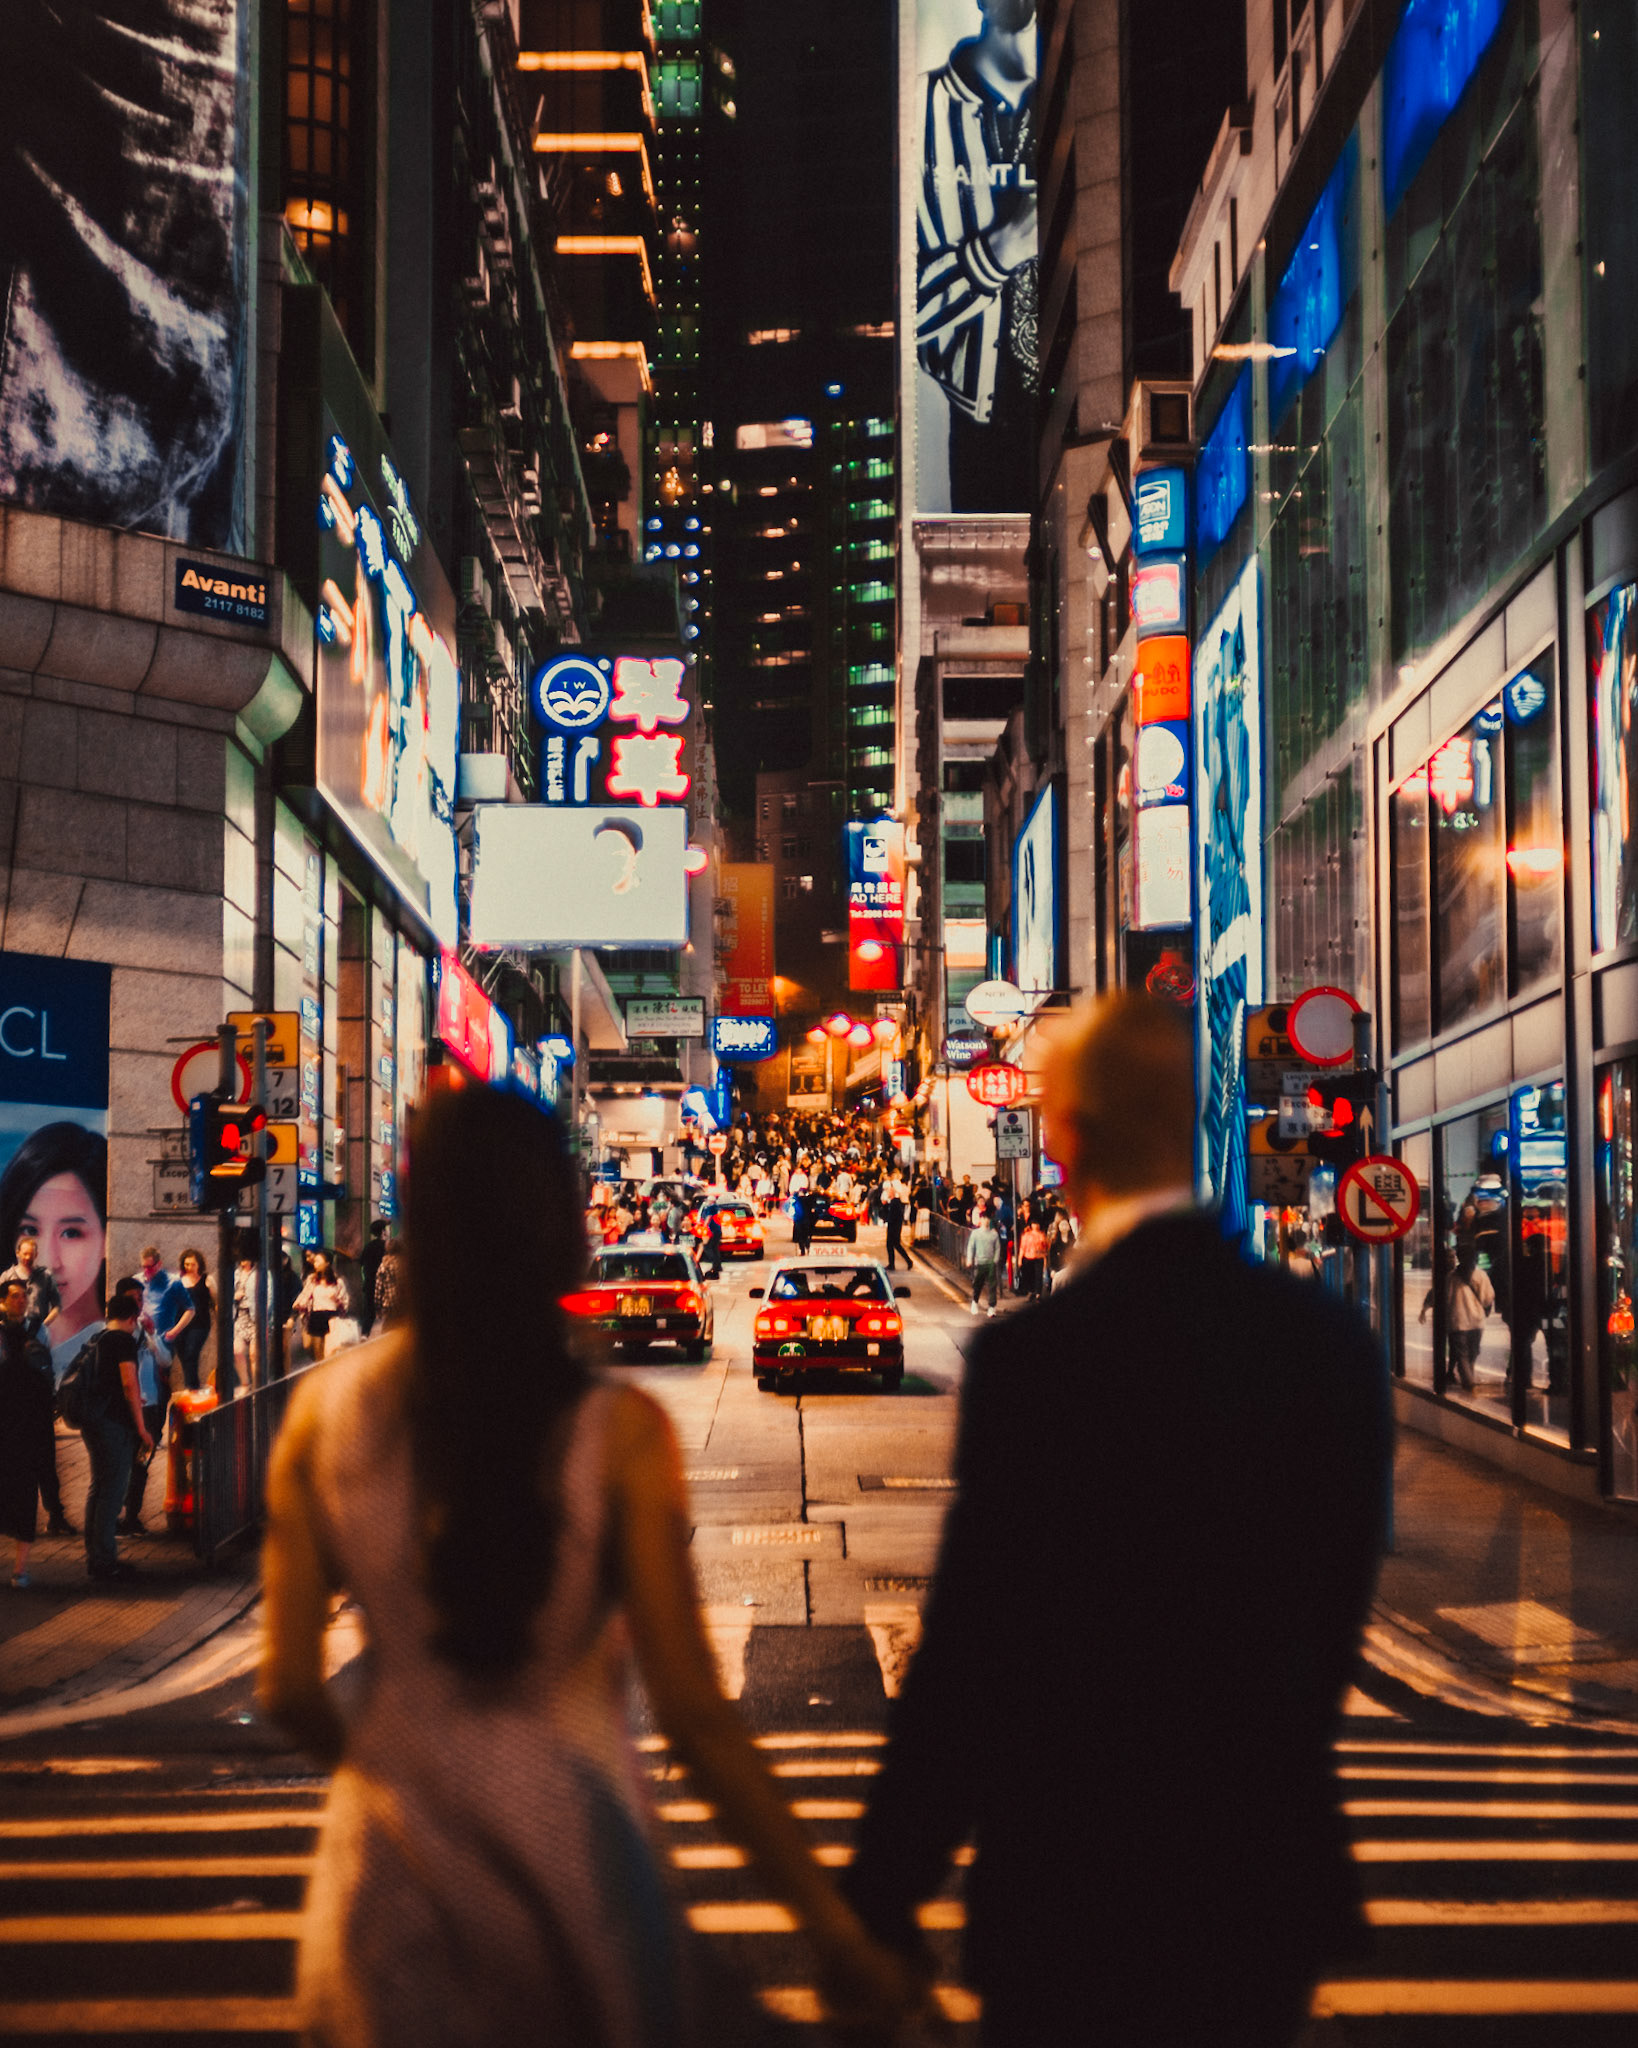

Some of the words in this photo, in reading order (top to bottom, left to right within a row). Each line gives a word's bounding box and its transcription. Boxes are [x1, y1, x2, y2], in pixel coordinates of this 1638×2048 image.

[181, 568, 266, 605] Avanti
[204, 596, 233, 612] 2117
[235, 603, 265, 620] 8182
[851, 894, 867, 903] AD
[870, 894, 901, 903] HERE
[739, 983, 751, 993] TO
[752, 983, 769, 993] LET
[946, 1039, 988, 1050] Watson's
[946, 1049, 972, 1060] Wine
[272, 1071, 284, 1088] 7
[272, 1099, 294, 1115] 12
[1017, 1136, 1024, 1145] 7
[1018, 1148, 1028, 1156] 12
[273, 1169, 285, 1185] 7
[273, 1194, 285, 1211] 7
[813, 1247, 845, 1255] TAXI
